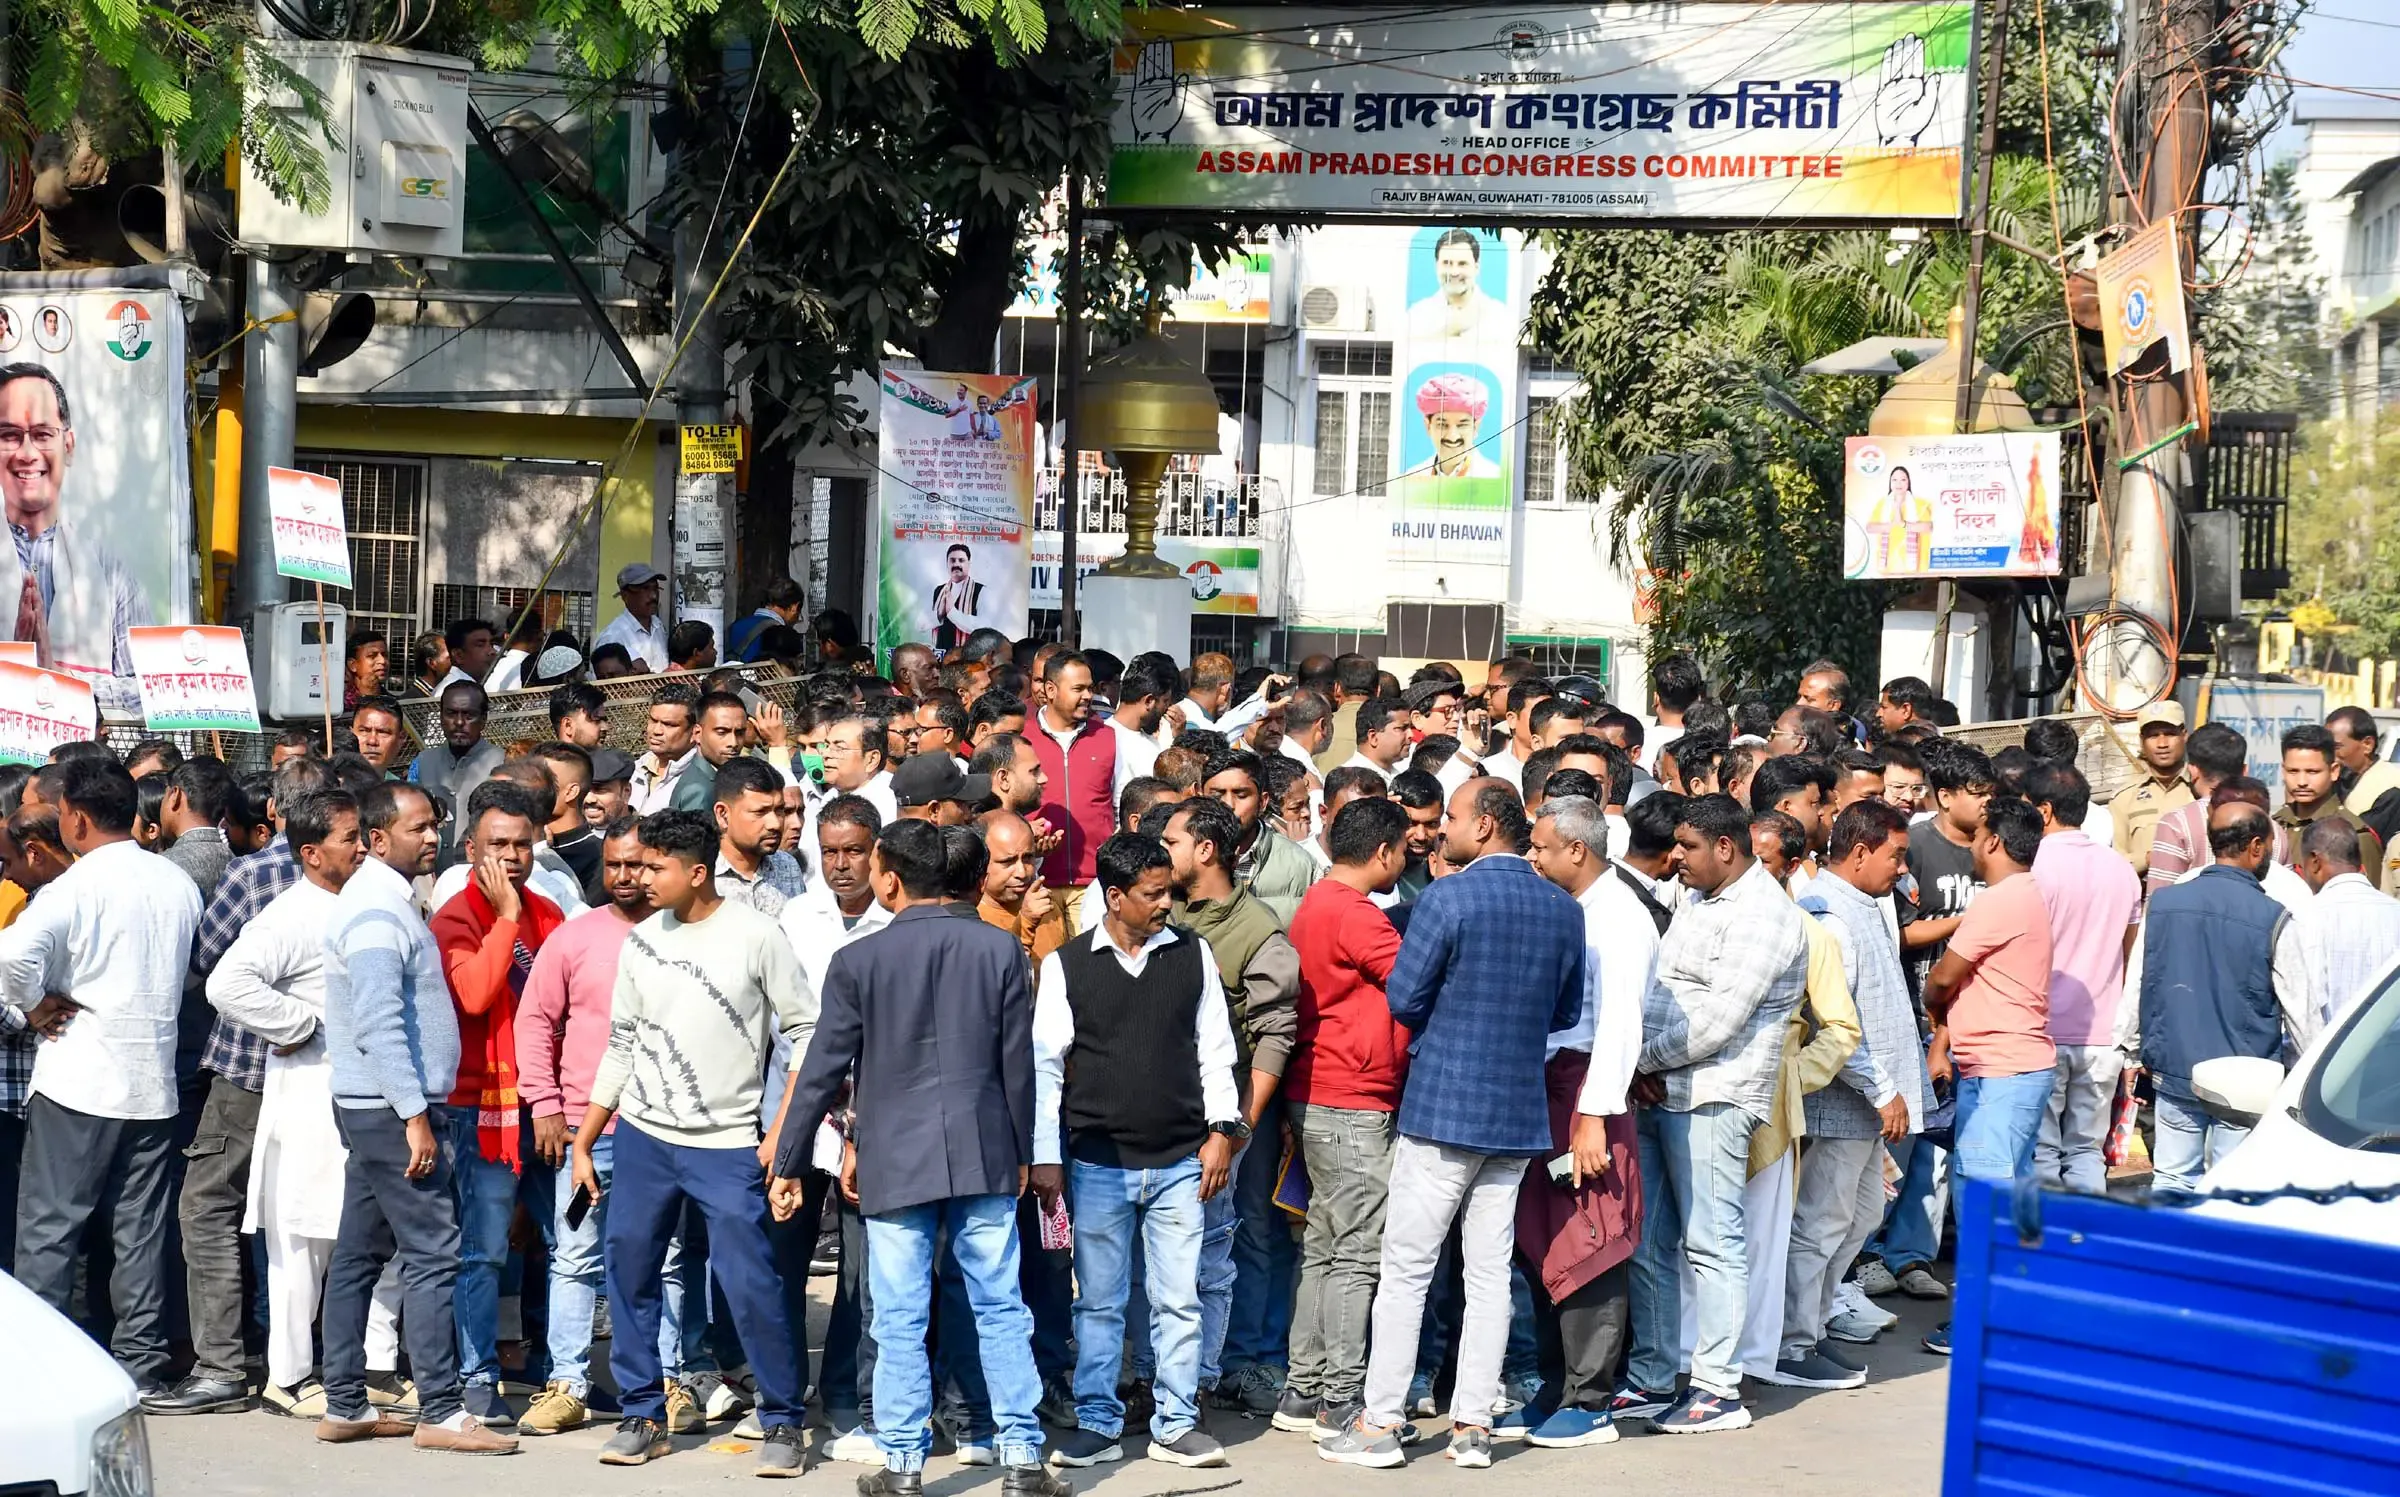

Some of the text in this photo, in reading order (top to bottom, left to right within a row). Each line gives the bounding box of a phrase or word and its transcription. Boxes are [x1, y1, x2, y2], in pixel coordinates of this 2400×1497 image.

[393, 100, 434, 113] STICK NO BILLS
[1213, 92, 1344, 128] অসম
[1353, 92, 1495, 132] প্ৰদেশ
[1462, 137, 1570, 149] HEAD OFFICE
[1196, 151, 1843, 178] ASSAM PRADESH CONGRESS COMMITTEE
[401, 177, 446, 196] GSC
[1382, 192, 1418, 202] RAJIV
[1420, 192, 1476, 204] BHAWAN,
[1478, 193, 1543, 203] GUWAHATI
[1551, 194, 1593, 204] 781005
[1596, 194, 1649, 205] (ASSAM)
[685, 426, 737, 438] TO-LET
[686, 452, 710, 461] 60003
[1940, 482, 2005, 505] ভোগালী
[1954, 508, 1996, 529] বিহুৰ
[1392, 522, 1503, 541] RAJIV BHAWAN
[175, 672, 208, 698] কুমাৰ
[26, 714, 50, 740] কুমাৰ
